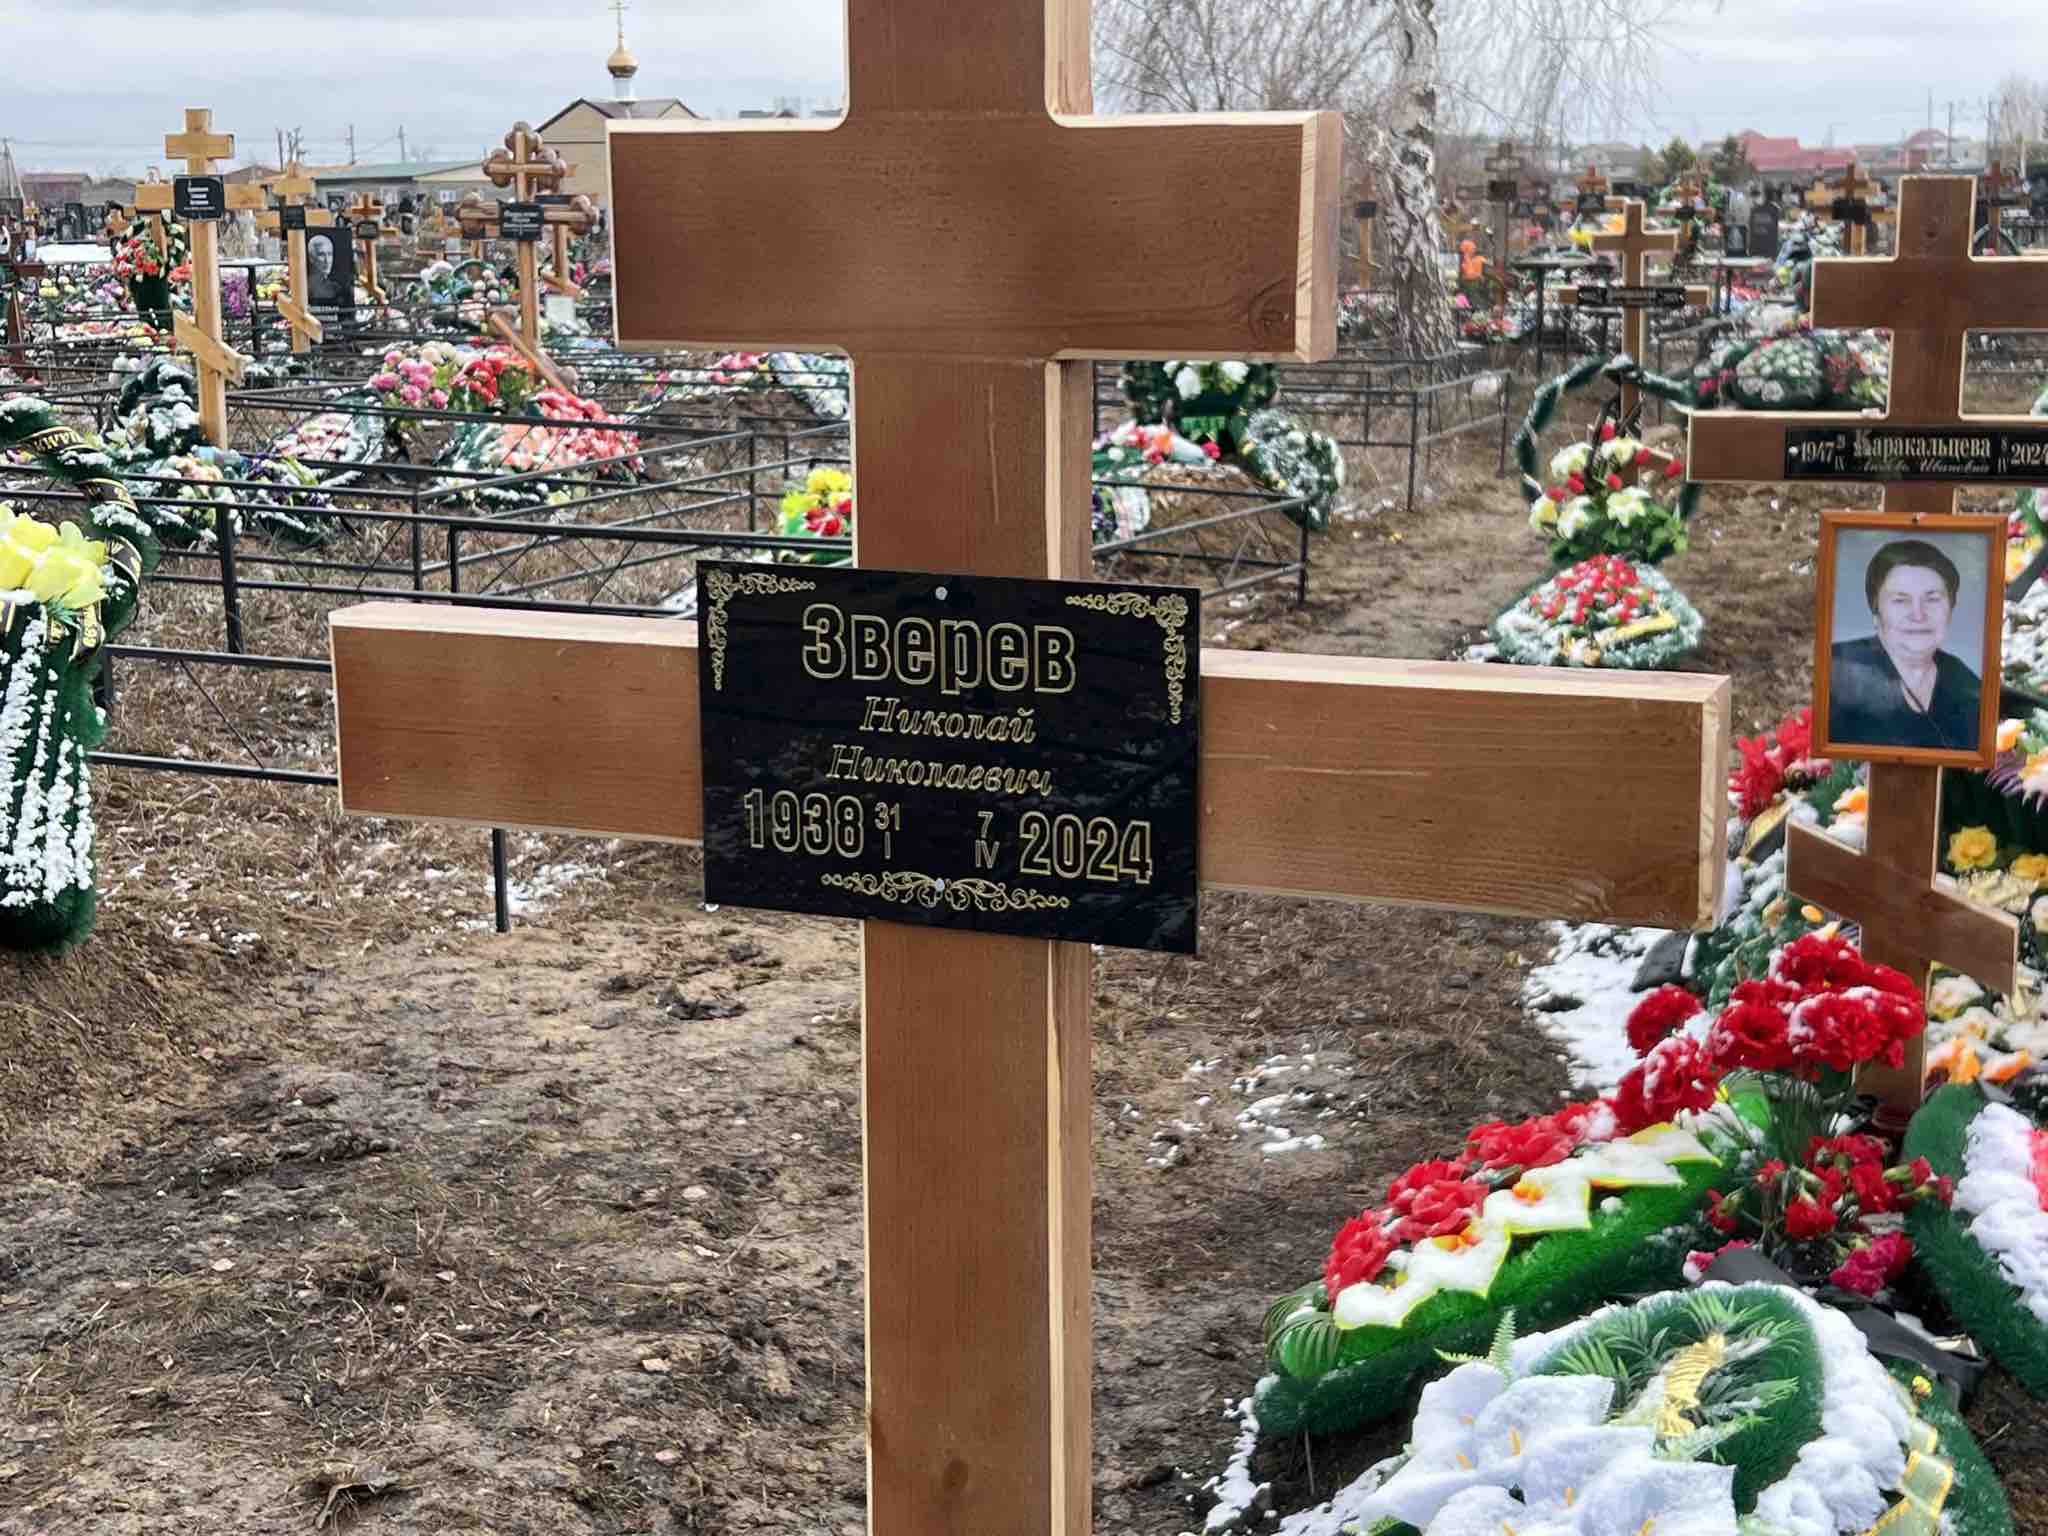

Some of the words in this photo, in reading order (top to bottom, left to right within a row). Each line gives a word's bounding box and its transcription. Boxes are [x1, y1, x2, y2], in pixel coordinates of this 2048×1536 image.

[1853, 430, 1991, 461] Каракальцева
[803, 603, 1076, 695] Зверев
[859, 696, 1037, 743] Николай
[826, 744, 1053, 796] Николаевич
[744, 789, 863, 858] 1938
[874, 802, 900, 831] 31
[977, 811, 994, 839] 7
[1019, 811, 1153, 884] 2024
[975, 839, 1000, 869] IV
